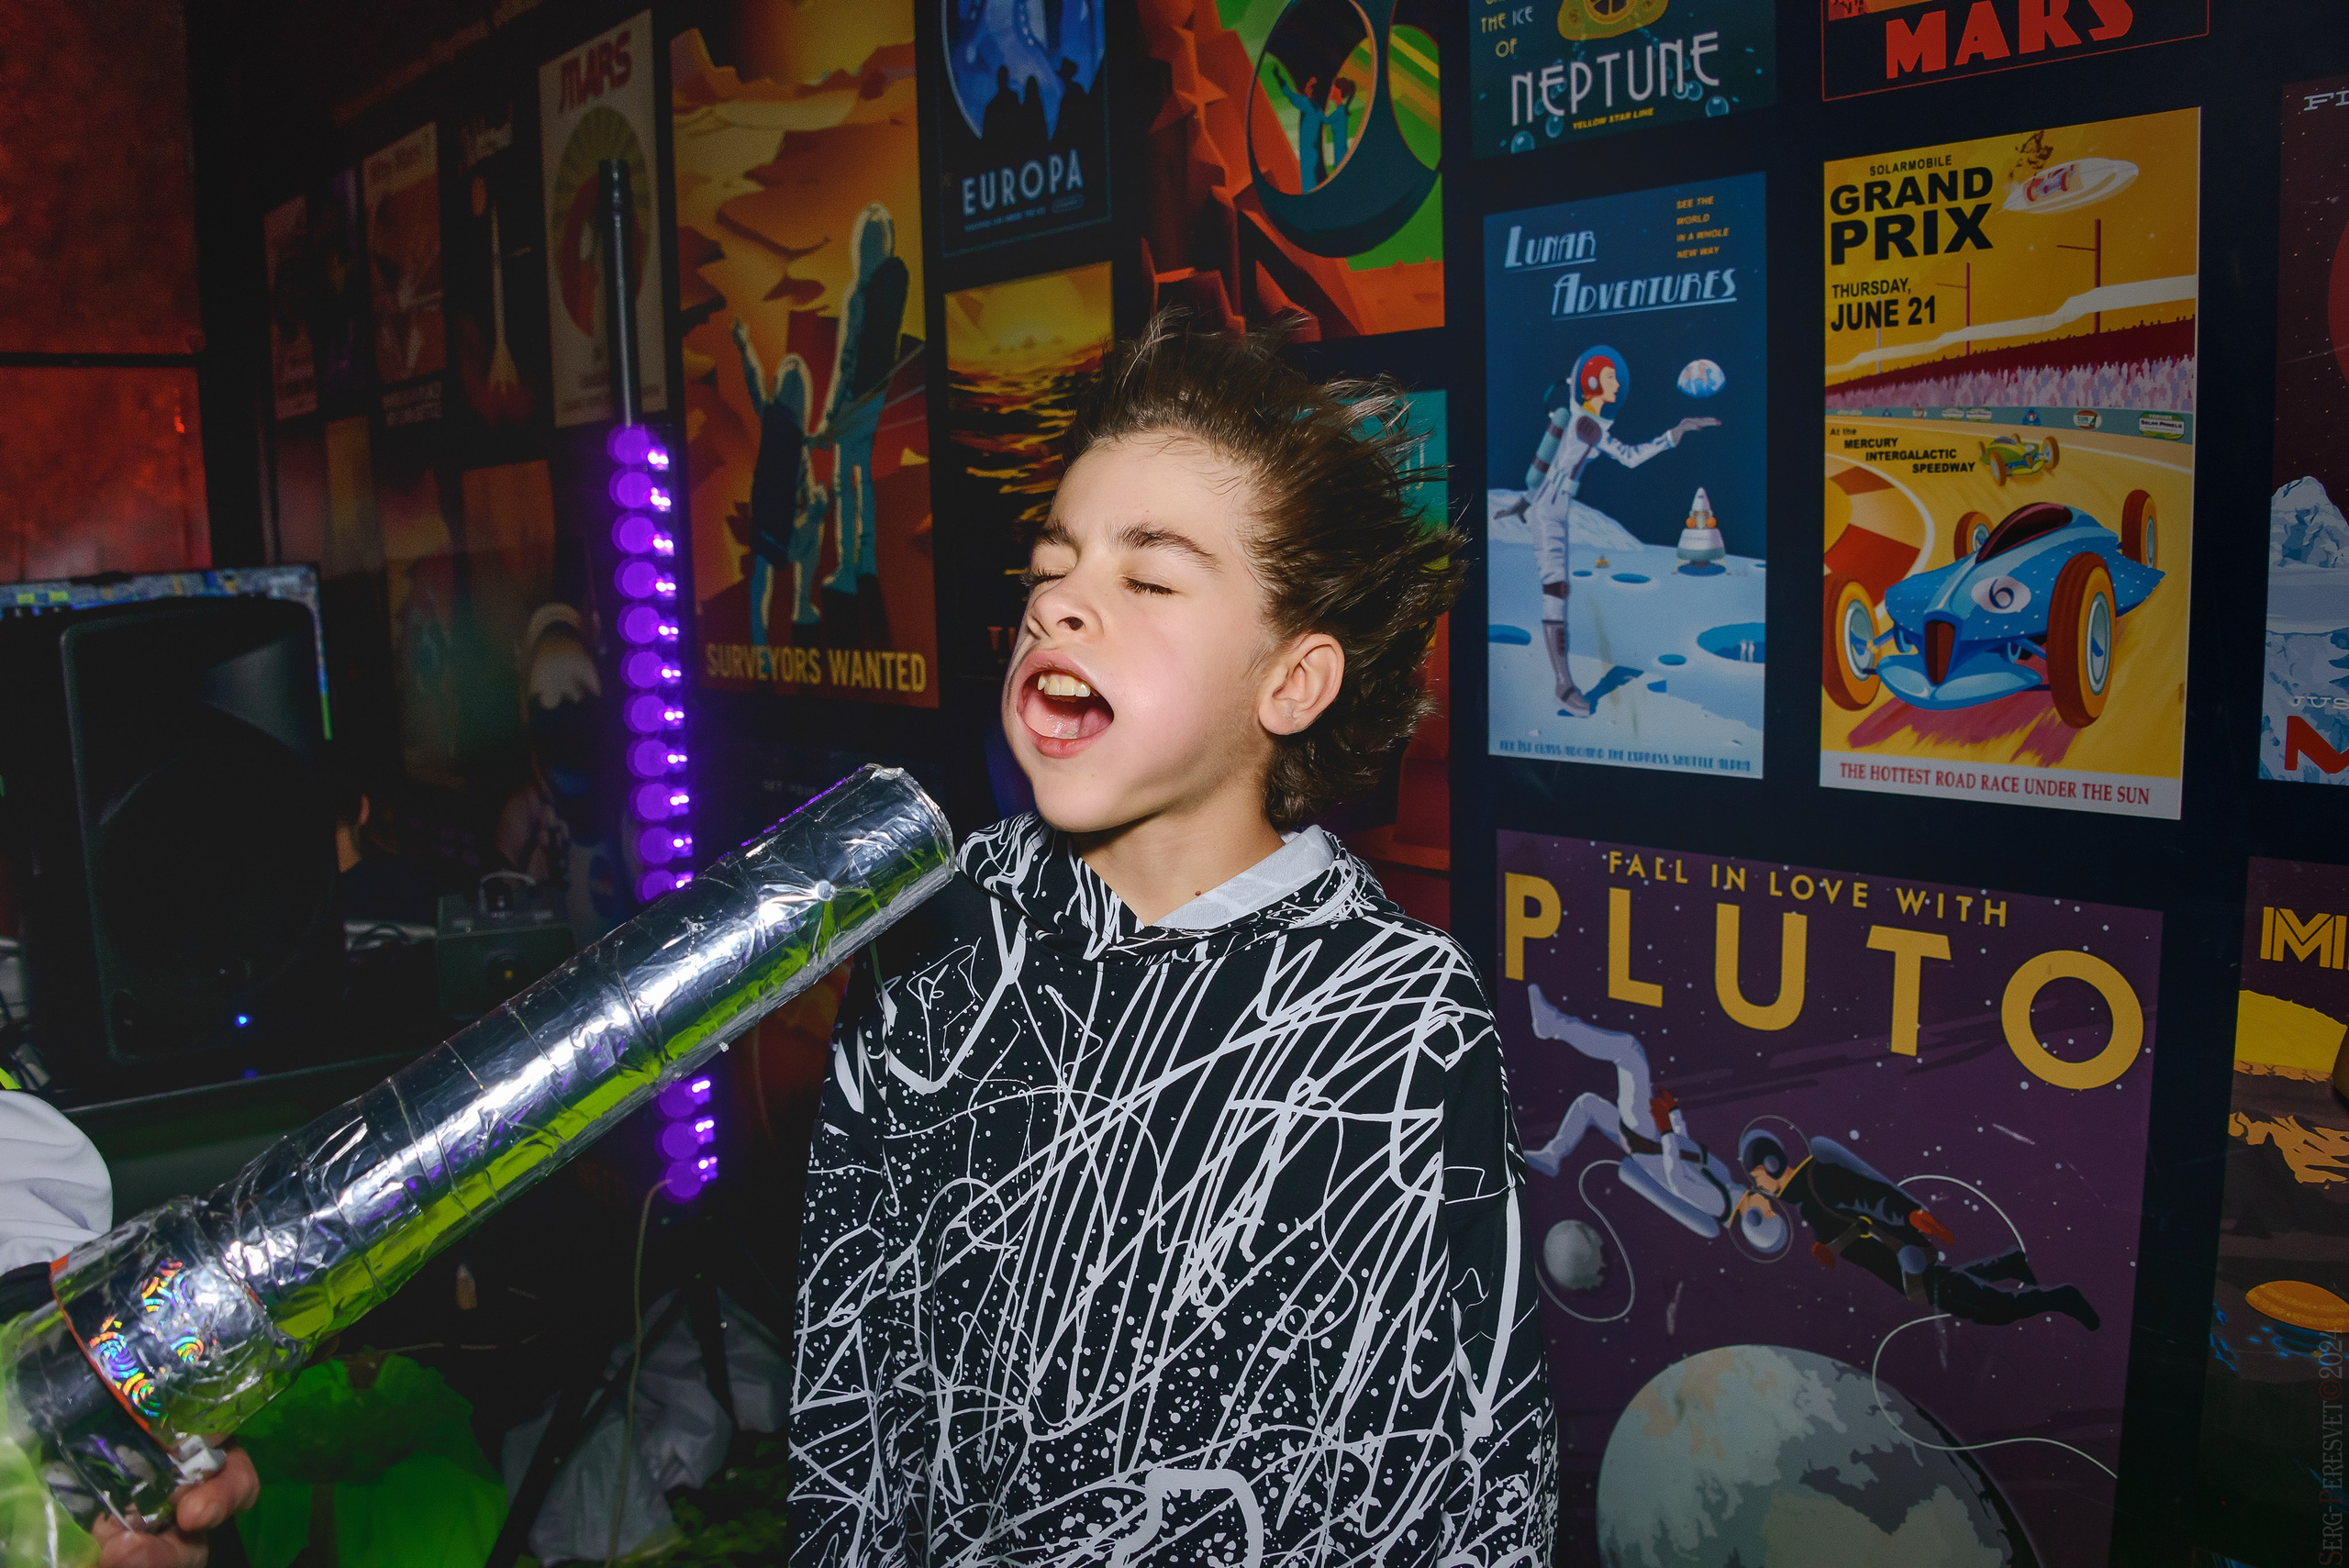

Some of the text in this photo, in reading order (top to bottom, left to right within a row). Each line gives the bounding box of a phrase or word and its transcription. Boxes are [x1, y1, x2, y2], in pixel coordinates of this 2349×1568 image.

[1481, 6, 1533, 34] THE ICE
[1495, 37, 1518, 58] OF
[1886, 0, 2134, 80] MARS
[1510, 30, 1720, 127] NEPTUNE
[1869, 154, 1952, 176] SOLARMOBILE
[962, 148, 1084, 217] EUROPA
[1830, 167, 1993, 216] GRAND
[1676, 195, 1714, 209] SEE THE
[1676, 213, 1710, 226] WORLD
[1696, 227, 1730, 239] WHOLE
[1831, 203, 1994, 265] PRIX
[1676, 246, 1720, 259] NEW WAY
[1831, 278, 1911, 299] THURSDAY,
[1831, 295, 1936, 331] JUNE 21
[1842, 428, 1857, 436] the
[1844, 438, 1898, 449] MERCURY
[1865, 449, 1957, 462] INTERGALACTIC
[1912, 462, 1976, 473] SPEEDWAY
[1989, 578, 2014, 609] 6
[706, 643, 927, 693] SURVEYORS WANTED
[1840, 762, 2150, 805] THE HOTTEST ROAD RACE UNDER THE SUN
[1609, 850, 2008, 928] FALL IN LOVE WITH
[1504, 871, 2144, 1090] PLUTO
